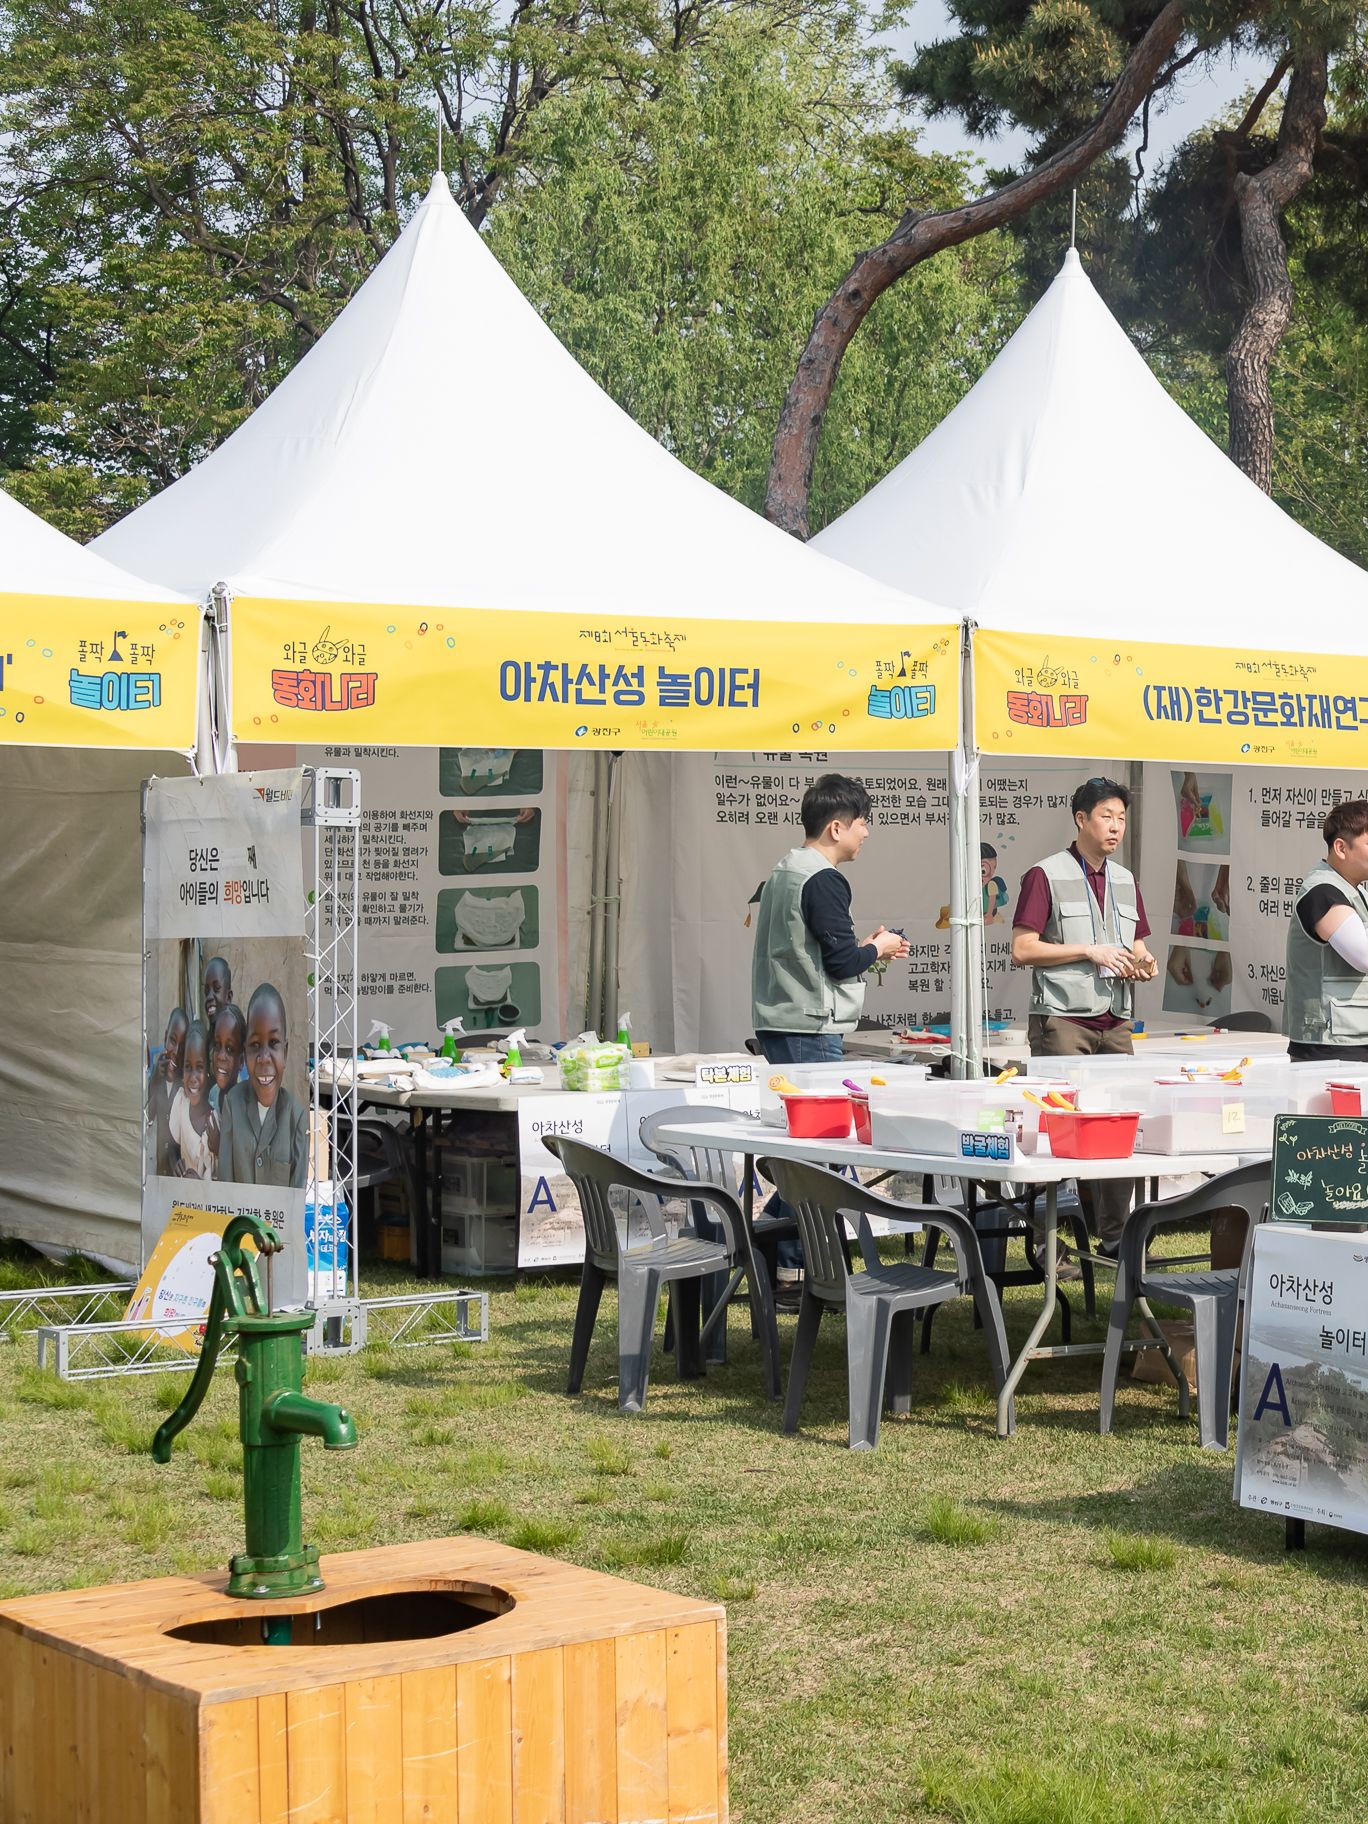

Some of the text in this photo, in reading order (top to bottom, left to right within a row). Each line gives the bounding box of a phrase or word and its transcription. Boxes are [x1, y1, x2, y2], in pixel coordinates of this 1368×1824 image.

[579, 626, 687, 652] 제8회 서울동화축제
[78, 639, 156, 666] 폴짝 폴짝
[283, 641, 367, 667] 와글 와글
[875, 660, 929, 680] 폴짝 폴짝
[1014, 667, 1079, 690] 와글 와글
[1235, 659, 1317, 682] 제8회 서울동화축제
[69, 668, 161, 711] 놀이터
[272, 668, 378, 711] 동화나라
[500, 659, 761, 709] 아차산성 놀이터
[868, 684, 936, 720] 놀이터
[1006, 690, 1089, 728] 동화나라
[592, 727, 621, 737] 광진구
[324, 747, 400, 759] 유물과 밀착시킨다.
[1253, 744, 1276, 754] 광진구
[788, 776, 800, 790] 다
[926, 778, 947, 791] 원래
[986, 778, 1028, 792] 어땠는지
[715, 792, 1044, 808] 알수가 모습 경우가
[1261, 787, 1283, 805] 먼저
[1285, 787, 1317, 806] 자신이
[362, 810, 434, 821] 이용하여 화선지와
[716, 810, 750, 826] 오히려
[755, 811, 779, 826] 오랜
[878, 812, 922, 826] 있으면서
[1261, 810, 1292, 828] 들어갈
[373, 822, 399, 832] 공기를
[362, 834, 407, 845] 밀착시킨다.
[189, 847, 220, 873] 당신은
[402, 846, 428, 857] 염려가
[373, 858, 419, 870] 등을 화선지
[179, 878, 270, 906] 아이들의 희망입니다
[1259, 876, 1280, 895] 줄의
[362, 890, 419, 902] 유물이 잘 밀착
[361, 903, 424, 915] 확인하고 물기가
[1259, 899, 1280, 917] 여러
[364, 915, 429, 927] 때까지 말려준다.
[908, 945, 940, 958] 하지만
[398, 983, 432, 994] 준비한다.
[908, 979, 944, 992] 복원 할
[876, 1012, 918, 1027] 사진처럼
[701, 1065, 752, 1084] 탁본체험
[531, 1119, 584, 1136] 아차산성
[961, 1132, 1010, 1160] 발굴체험
[1296, 1142, 1353, 1161] 아차산성
[527, 1175, 558, 1214] A
[1320, 1179, 1364, 1202] 놀아요
[1269, 1273, 1334, 1305] 아차산성
[1319, 1324, 1367, 1356] 놀이터
[1253, 1362, 1292, 1427] A
